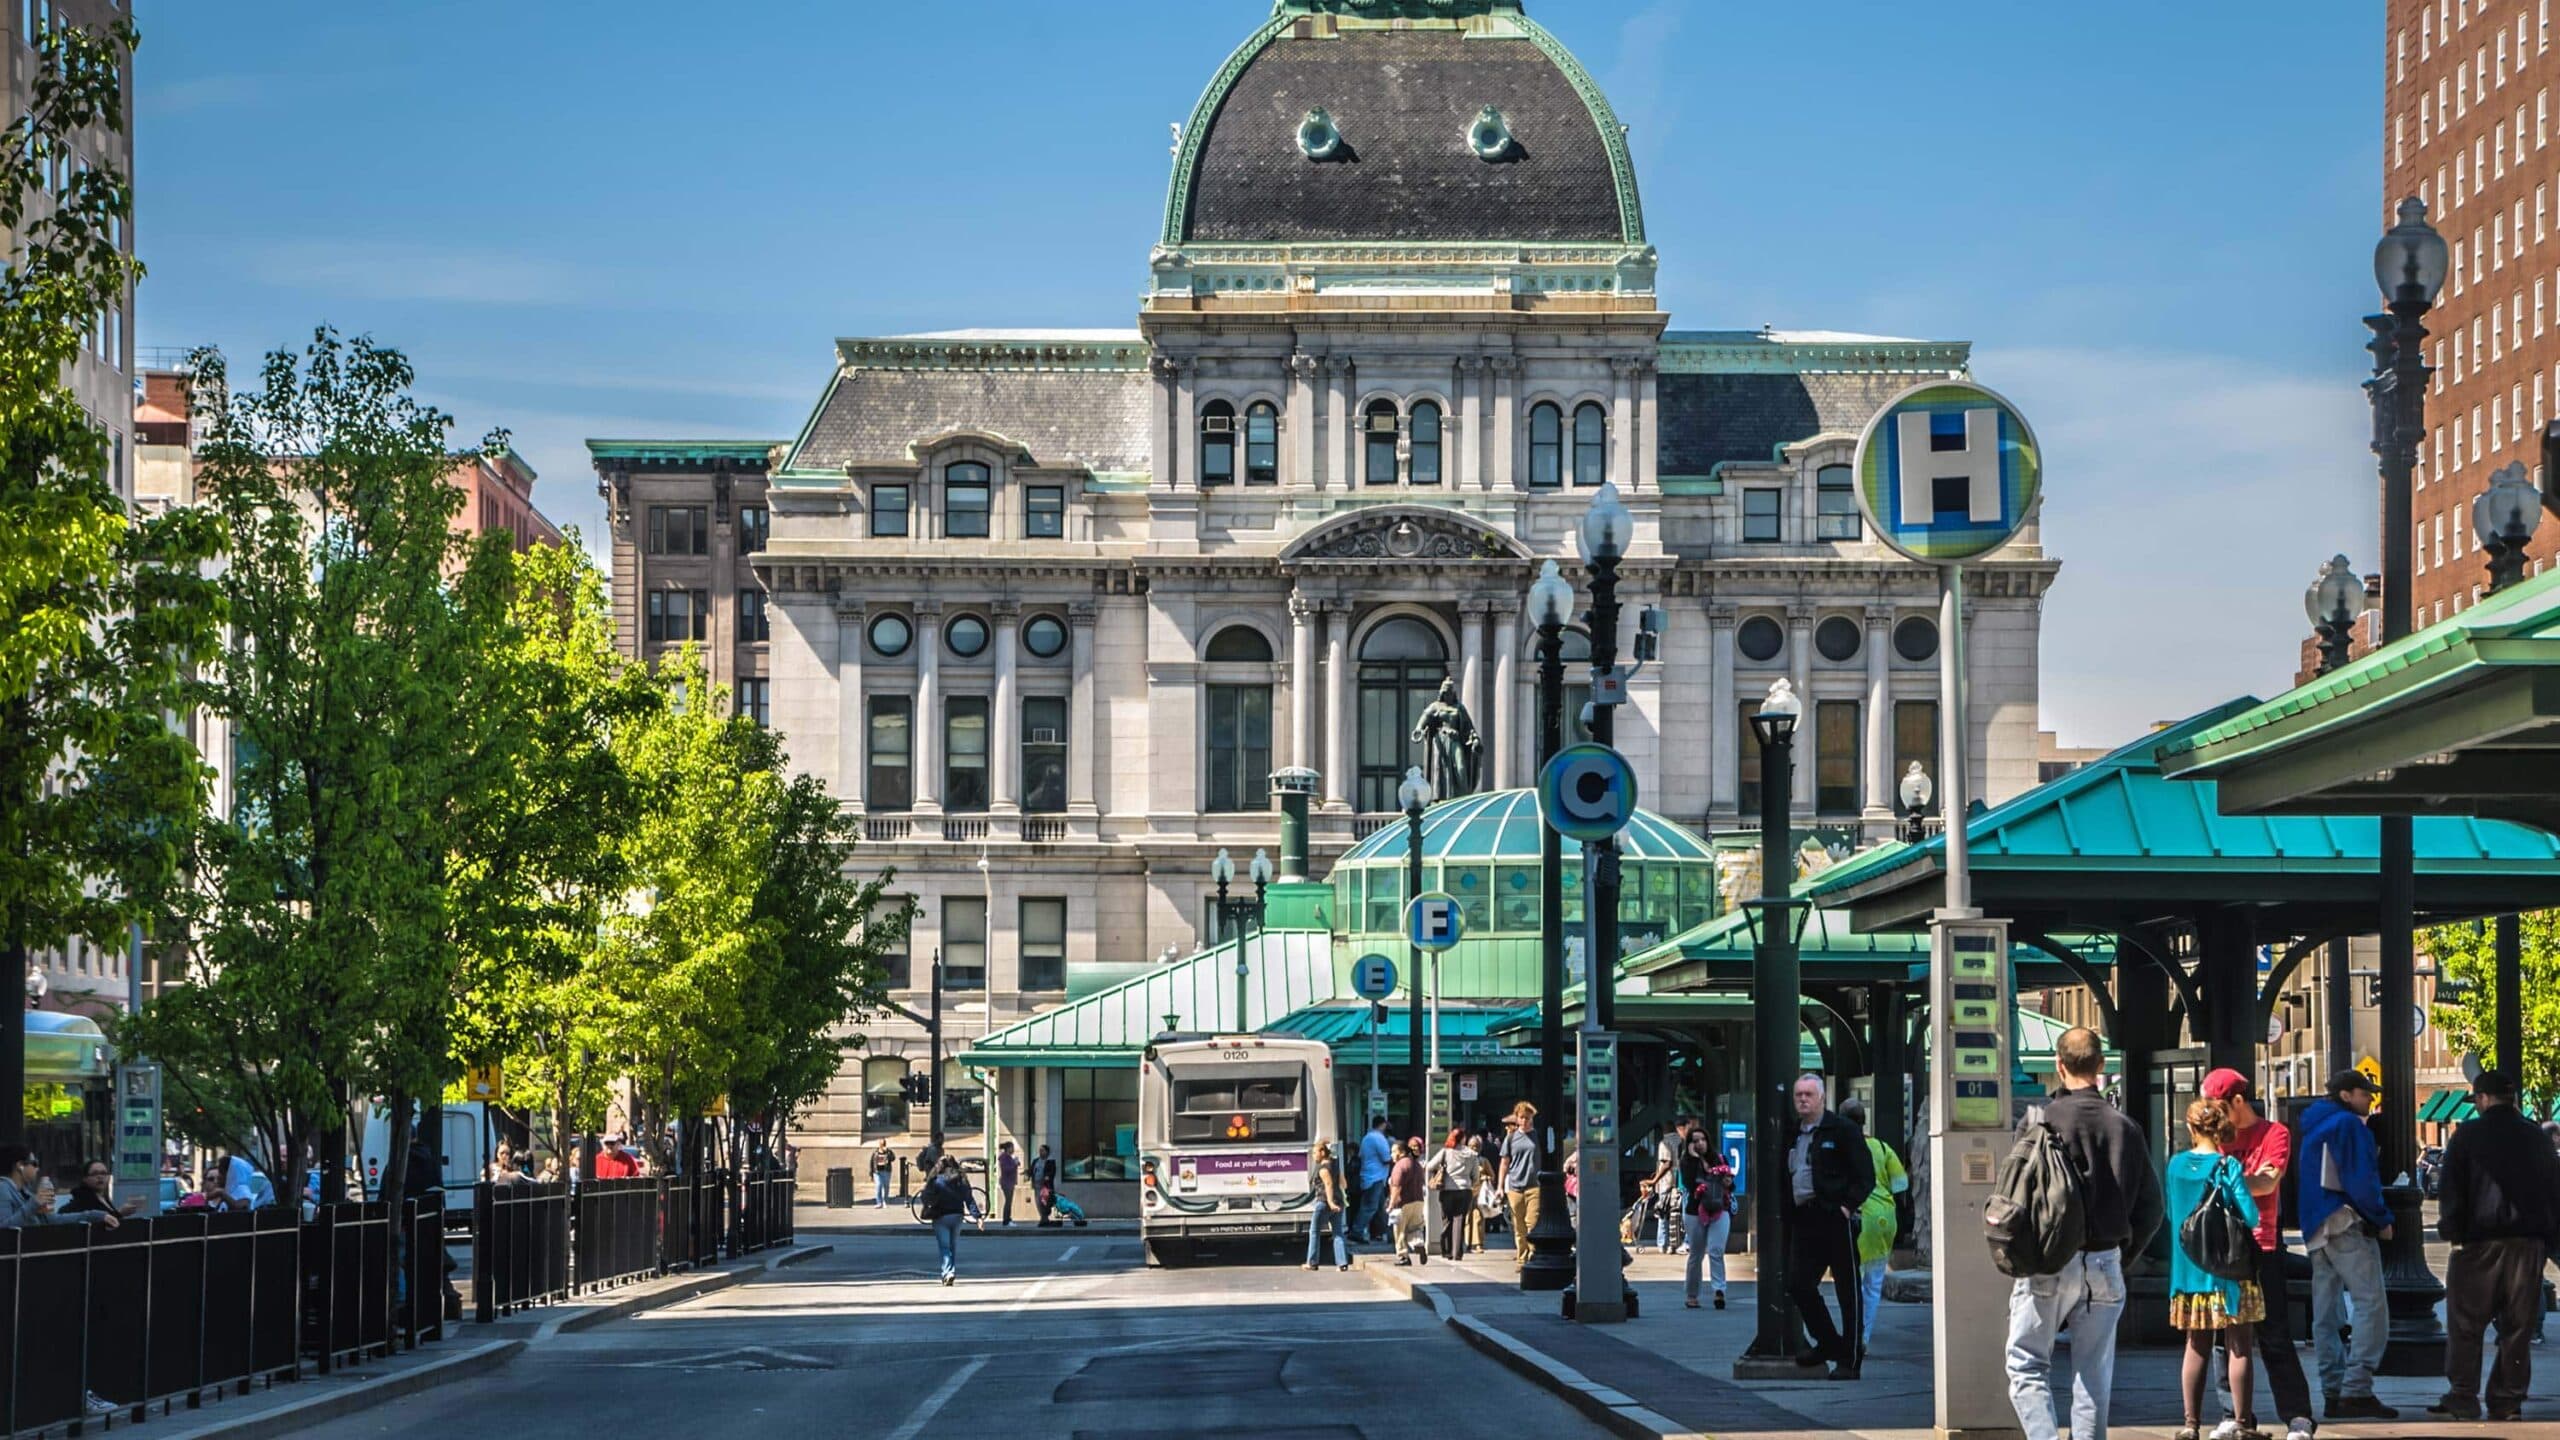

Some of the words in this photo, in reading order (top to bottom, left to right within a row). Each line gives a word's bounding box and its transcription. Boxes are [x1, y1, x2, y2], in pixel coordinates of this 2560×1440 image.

[1898, 408, 2001, 525] H
[1422, 901, 1449, 940] F
[1364, 959, 1385, 991] E
[1223, 1050, 1249, 1060] 0120
[1968, 1081, 1983, 1095] 01
[1215, 1160, 1233, 1169] Food
[1241, 1161, 1258, 1169] your
[1258, 1159, 1292, 1169] fingertips.
